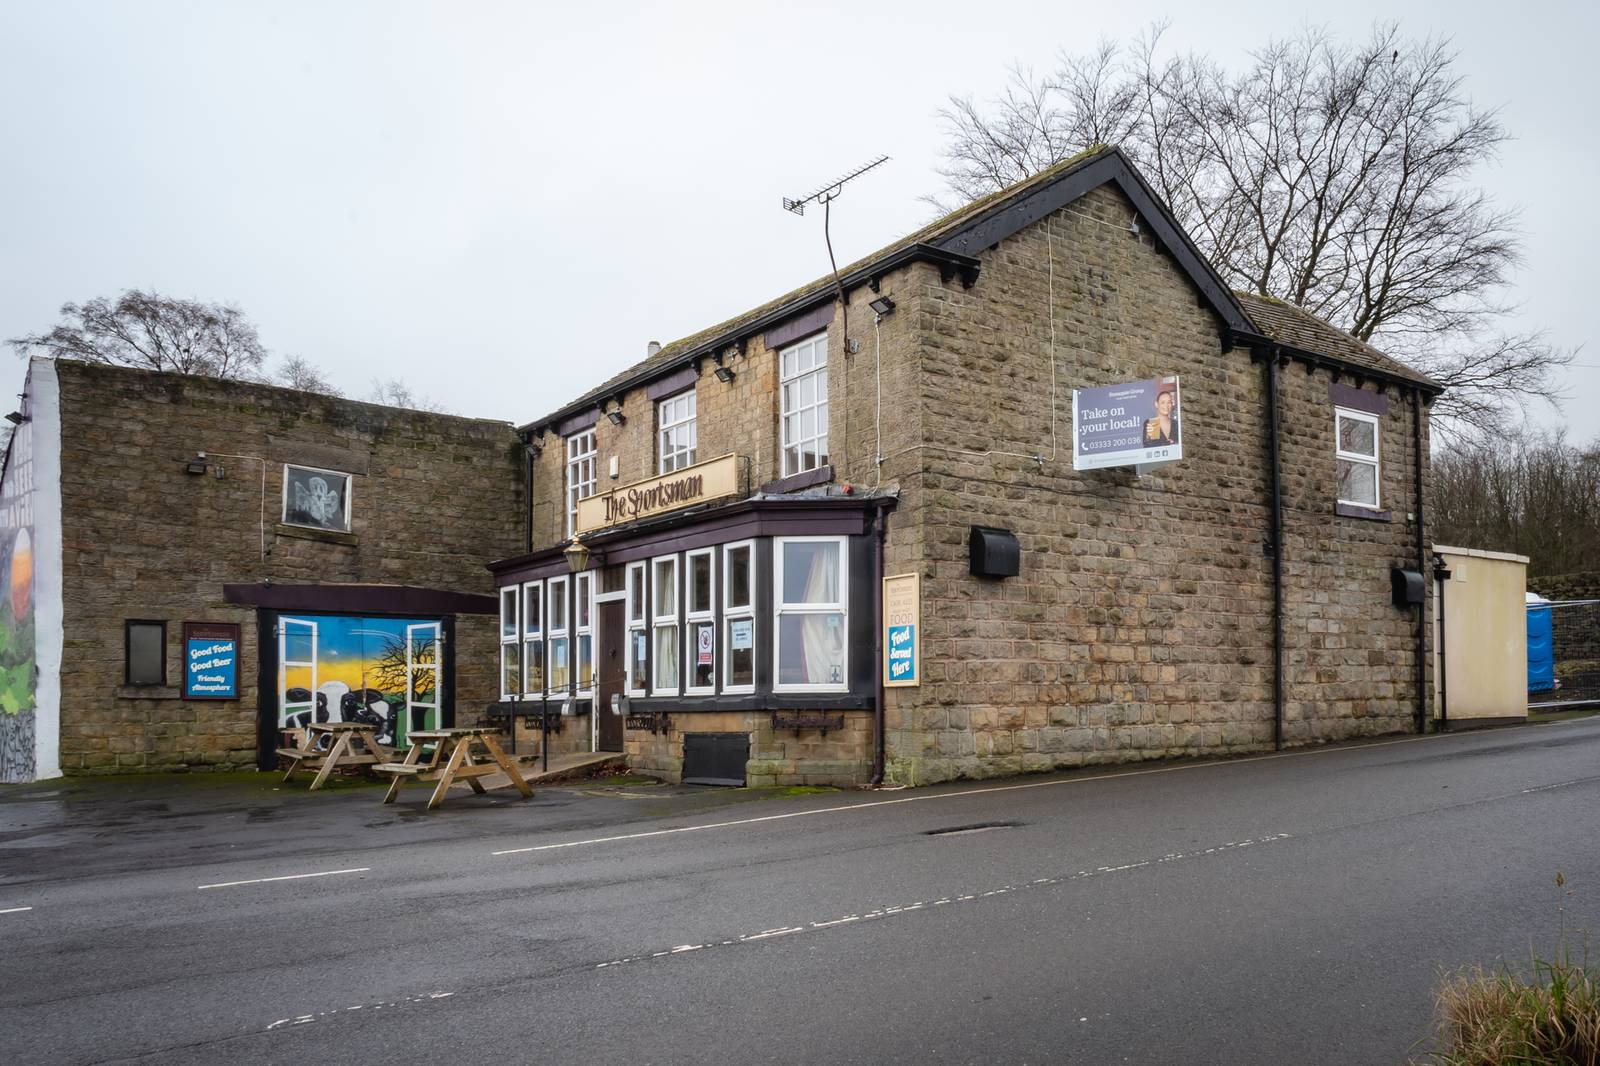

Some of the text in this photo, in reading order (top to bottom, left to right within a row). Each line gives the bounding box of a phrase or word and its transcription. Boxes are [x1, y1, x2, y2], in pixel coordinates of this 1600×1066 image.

[1081, 407, 1125, 420] Take on
[1081, 417, 1140, 435] your local!
[1089, 440, 1112, 449] 03333
[1113, 438, 1126, 447] 200
[601, 474, 704, 526] The Sportsman
[891, 626, 910, 647] Food
[190, 643, 233, 659] Good Food
[890, 647, 912, 660] Served
[190, 659, 232, 672] Good Beer
[891, 661, 910, 677] Here
[197, 675, 225, 683] Friendly
